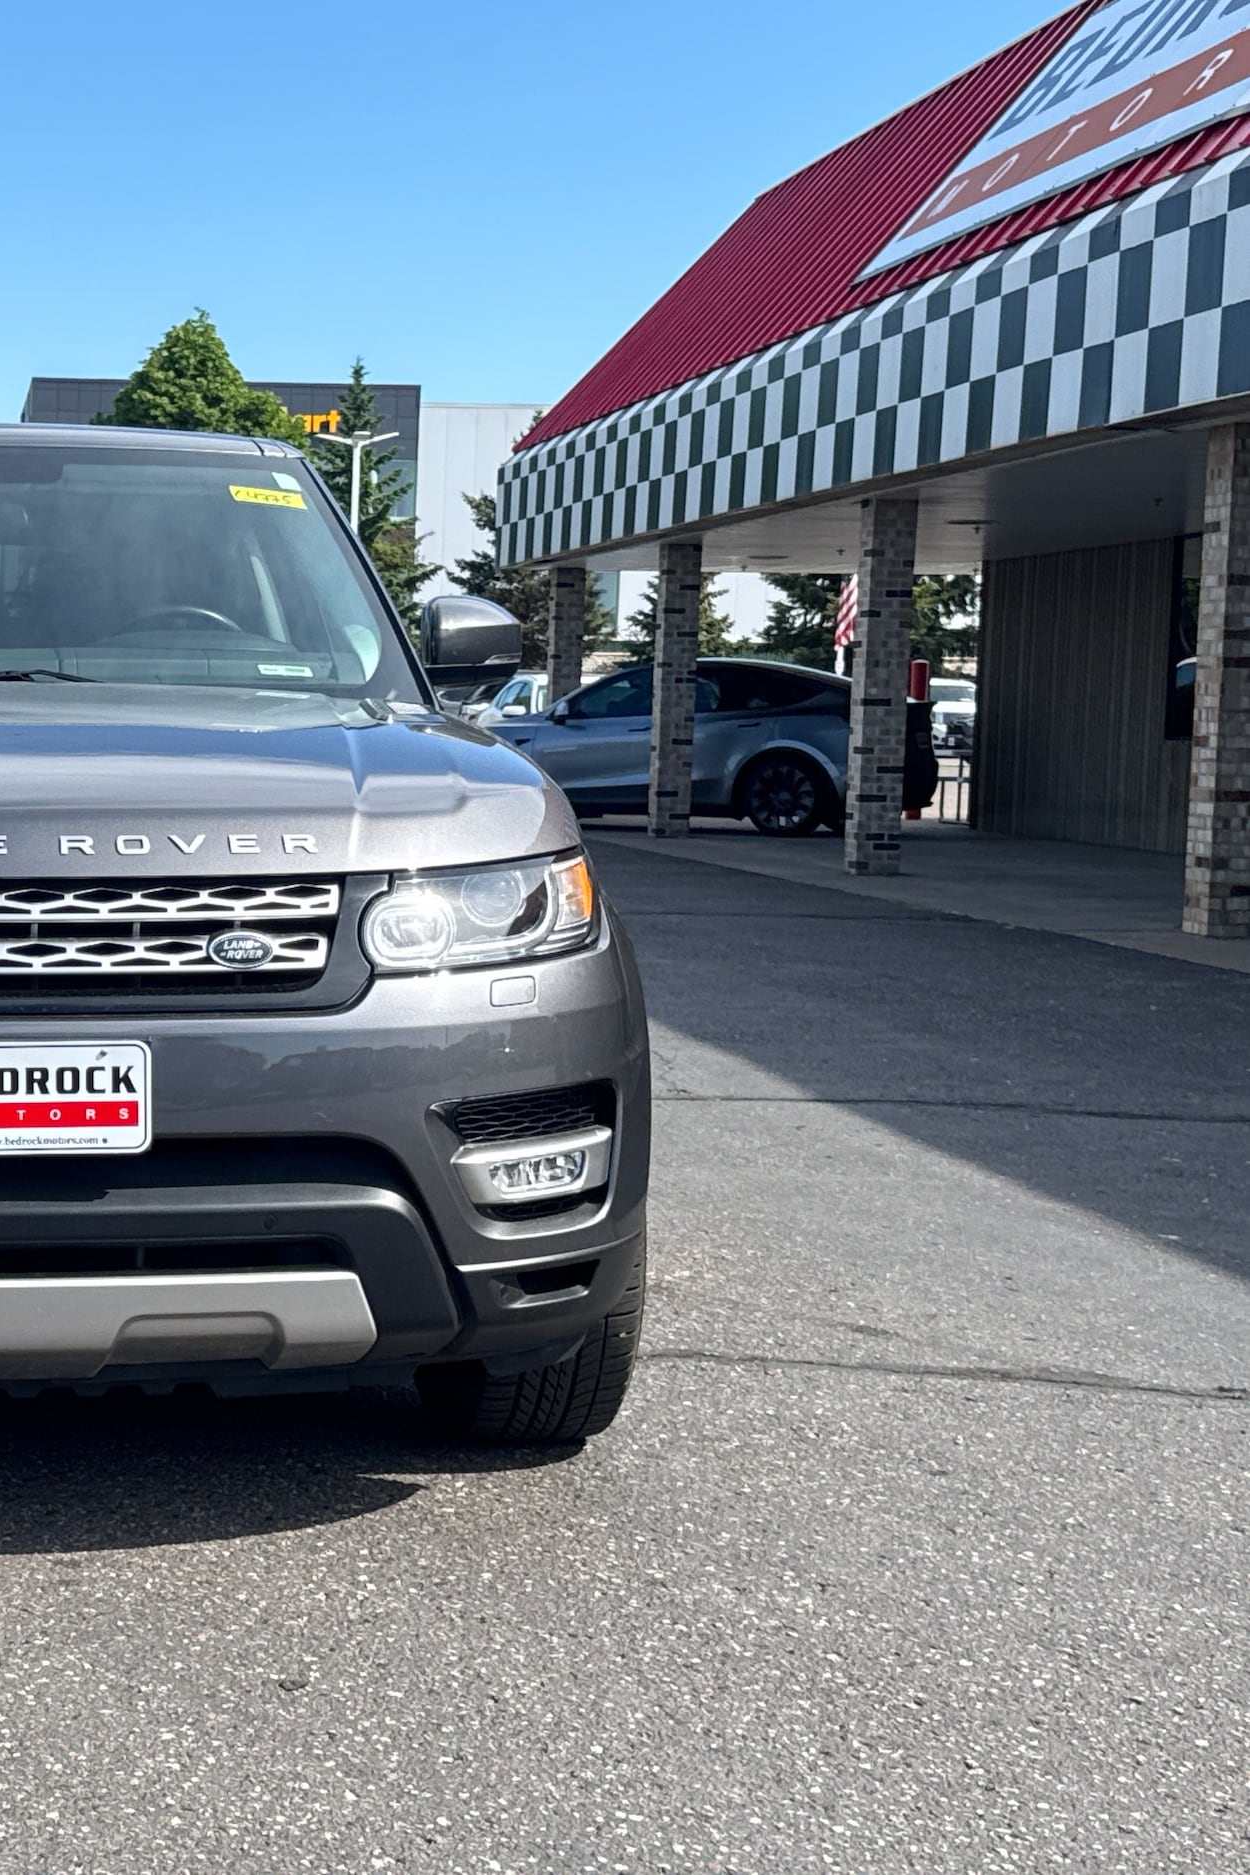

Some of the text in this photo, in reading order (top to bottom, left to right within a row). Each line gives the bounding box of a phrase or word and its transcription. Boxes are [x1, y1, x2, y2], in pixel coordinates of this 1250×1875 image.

[279, 406, 341, 433] art
[58, 834, 318, 855] ROVER
[223, 940, 255, 950] LAND
[226, 950, 263, 960] ROVER
